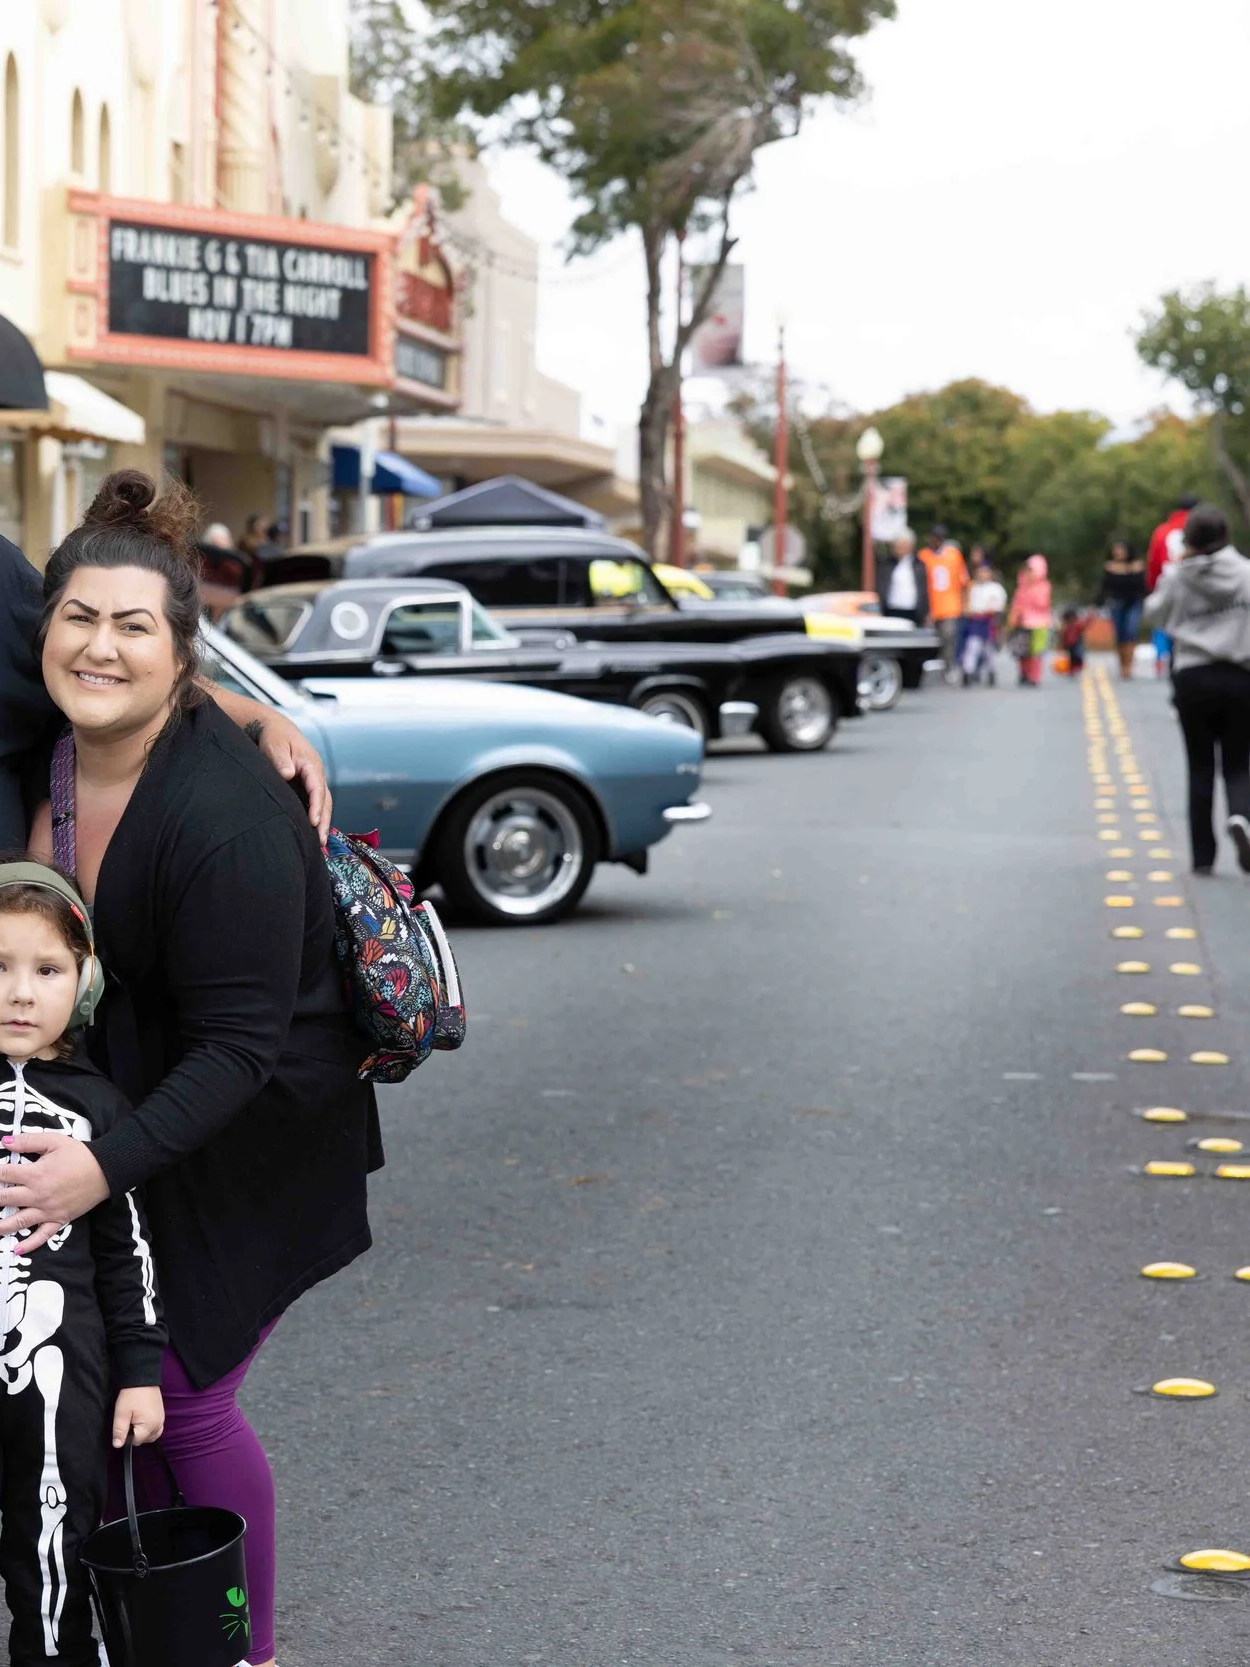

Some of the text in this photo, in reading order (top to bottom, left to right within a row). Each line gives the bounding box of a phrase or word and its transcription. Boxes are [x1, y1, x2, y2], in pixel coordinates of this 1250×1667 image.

[111, 227, 368, 291] FRANKIE G & TIA CARROLL
[142, 266, 342, 321] BLUES IN THE NIGHT
[188, 306, 232, 344] NOV
